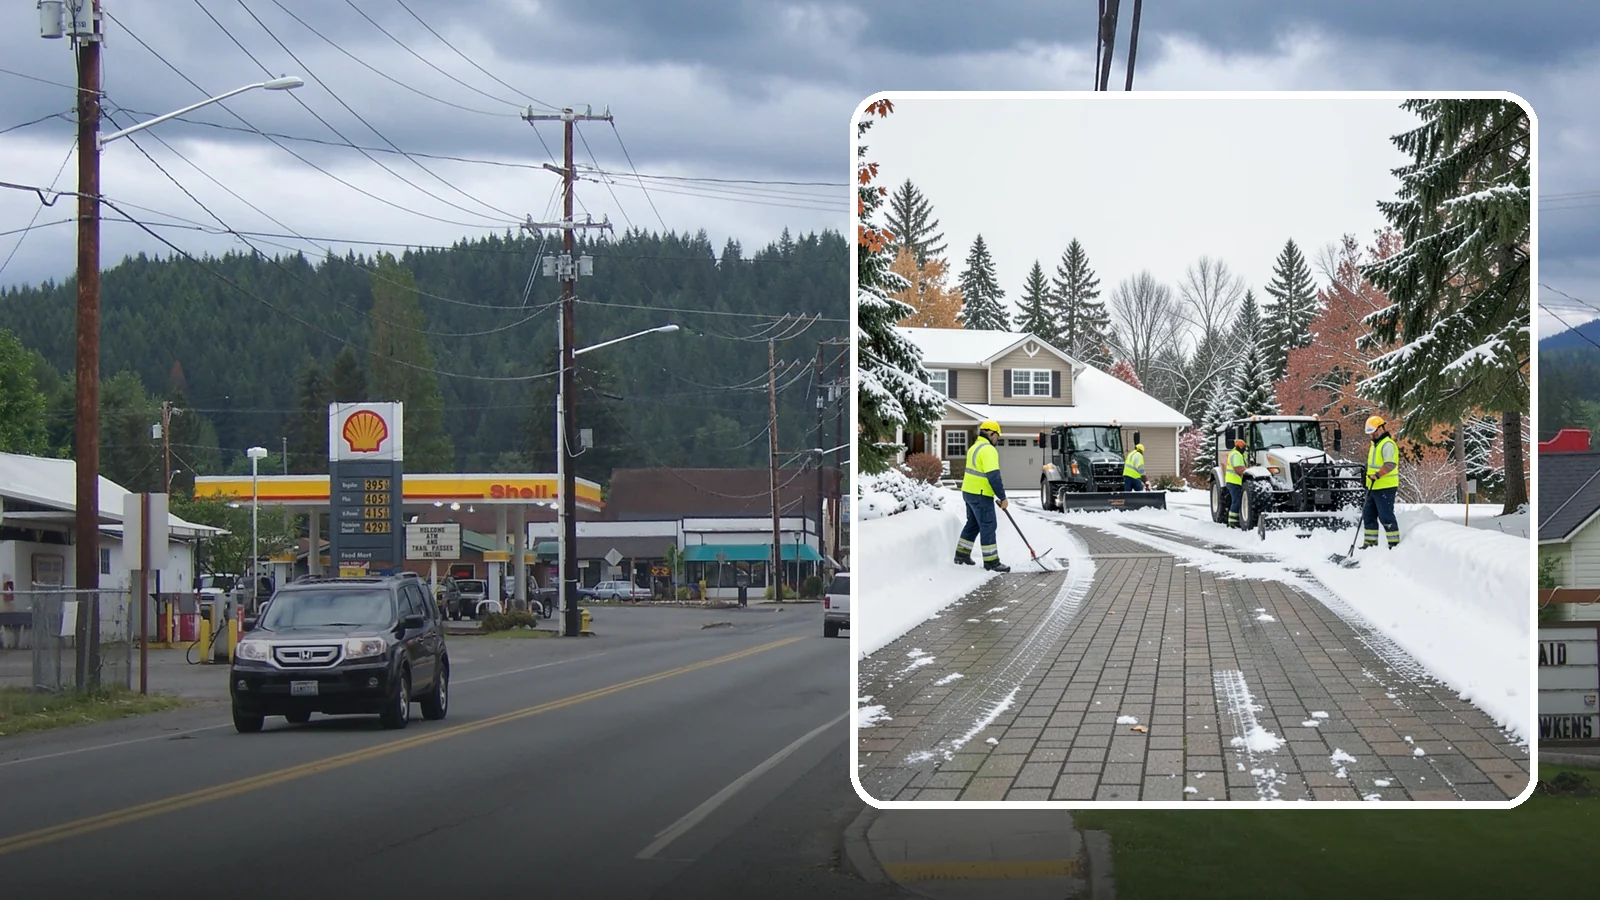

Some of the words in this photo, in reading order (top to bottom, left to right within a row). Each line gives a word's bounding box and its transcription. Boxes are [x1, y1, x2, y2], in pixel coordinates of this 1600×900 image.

[366, 480, 383, 490] 395
[490, 484, 547, 499] Shell
[365, 494, 383, 504] 405
[365, 508, 383, 518] 415
[366, 522, 383, 532] 429
[1539, 643, 1566, 665] AID
